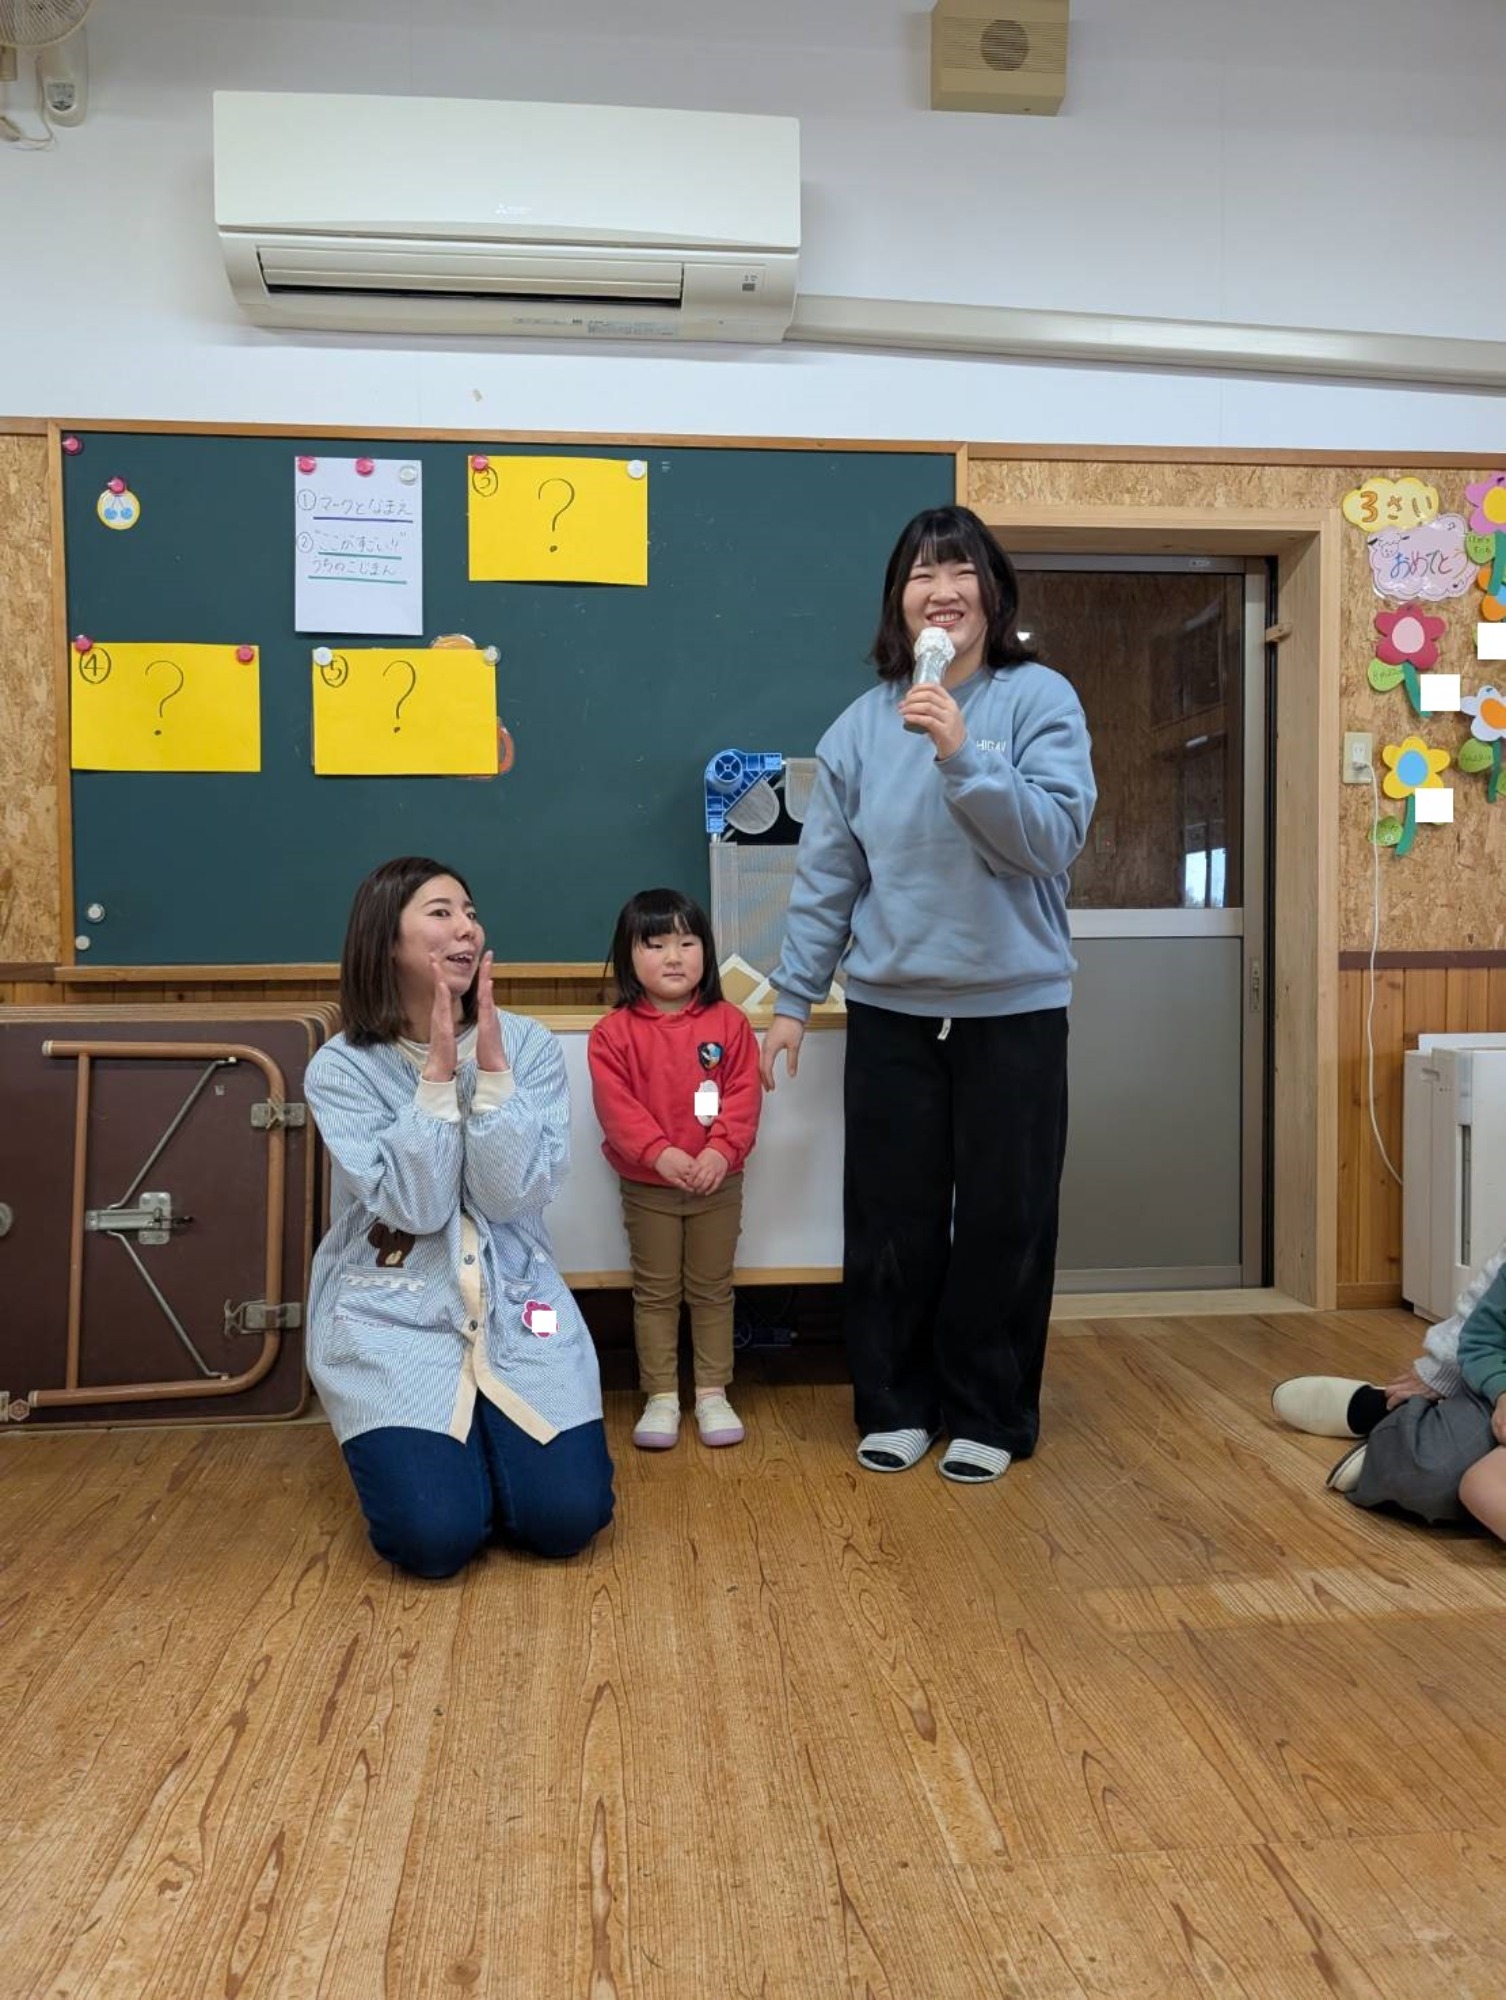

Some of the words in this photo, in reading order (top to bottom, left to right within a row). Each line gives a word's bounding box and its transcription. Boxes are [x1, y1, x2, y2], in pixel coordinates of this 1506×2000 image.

[537, 478, 575, 553] ?
[145, 660, 184, 736] ?
[382, 660, 416, 733] ?
